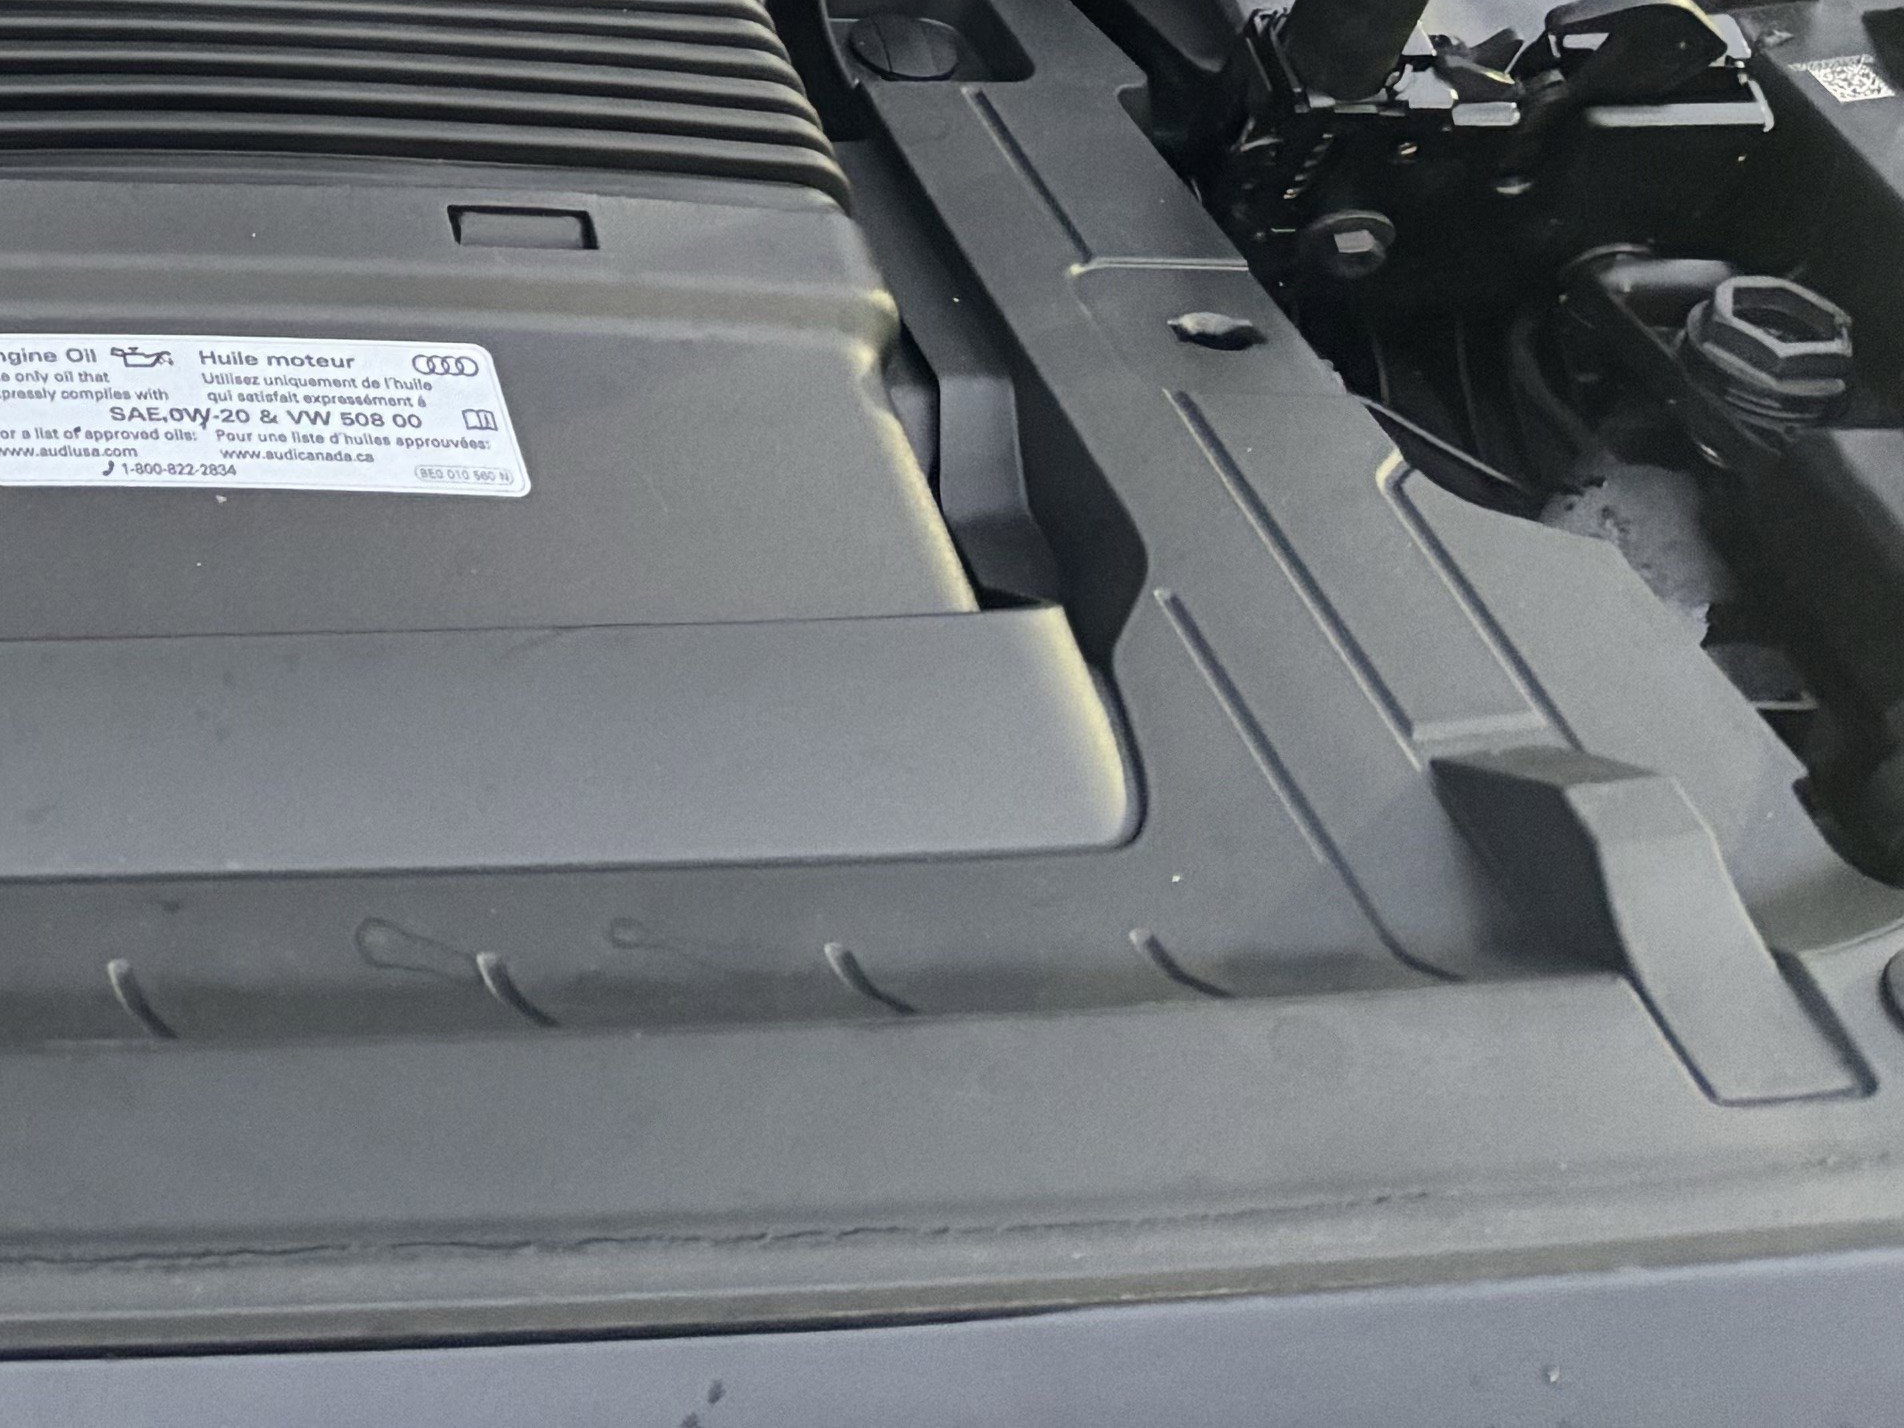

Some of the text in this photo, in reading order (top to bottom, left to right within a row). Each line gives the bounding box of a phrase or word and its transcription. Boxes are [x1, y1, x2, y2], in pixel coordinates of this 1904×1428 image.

[65, 348, 97, 363] Oil
[199, 350, 355, 369] Huile moteur
[14, 371, 48, 384] only
[54, 370, 74, 383] oil
[77, 371, 110, 383] that
[202, 372, 433, 392] Utilisez uniquement de l'huile
[60, 388, 131, 403] complies
[135, 389, 169, 401] with
[207, 391, 233, 404] qui
[237, 391, 299, 405] satisfait
[303, 393, 414, 408] expressément
[260, 410, 278, 425] &
[287, 410, 332, 426] VW
[341, 413, 386, 427] 508
[392, 413, 423, 428] 00
[21, 430, 31, 439] a
[35, 428, 58, 440] list
[63, 427, 81, 440] of
[84, 429, 159, 442] approved
[164, 429, 197, 441] oils:
[216, 430, 253, 443] Pour
[257, 433, 287, 443] une
[292, 432, 326, 444] liste
[329, 433, 391, 446] d'huiles
[220, 449, 374, 463] www.audicanada.ca
[122, 461, 237, 477] 1-800-822-2834
